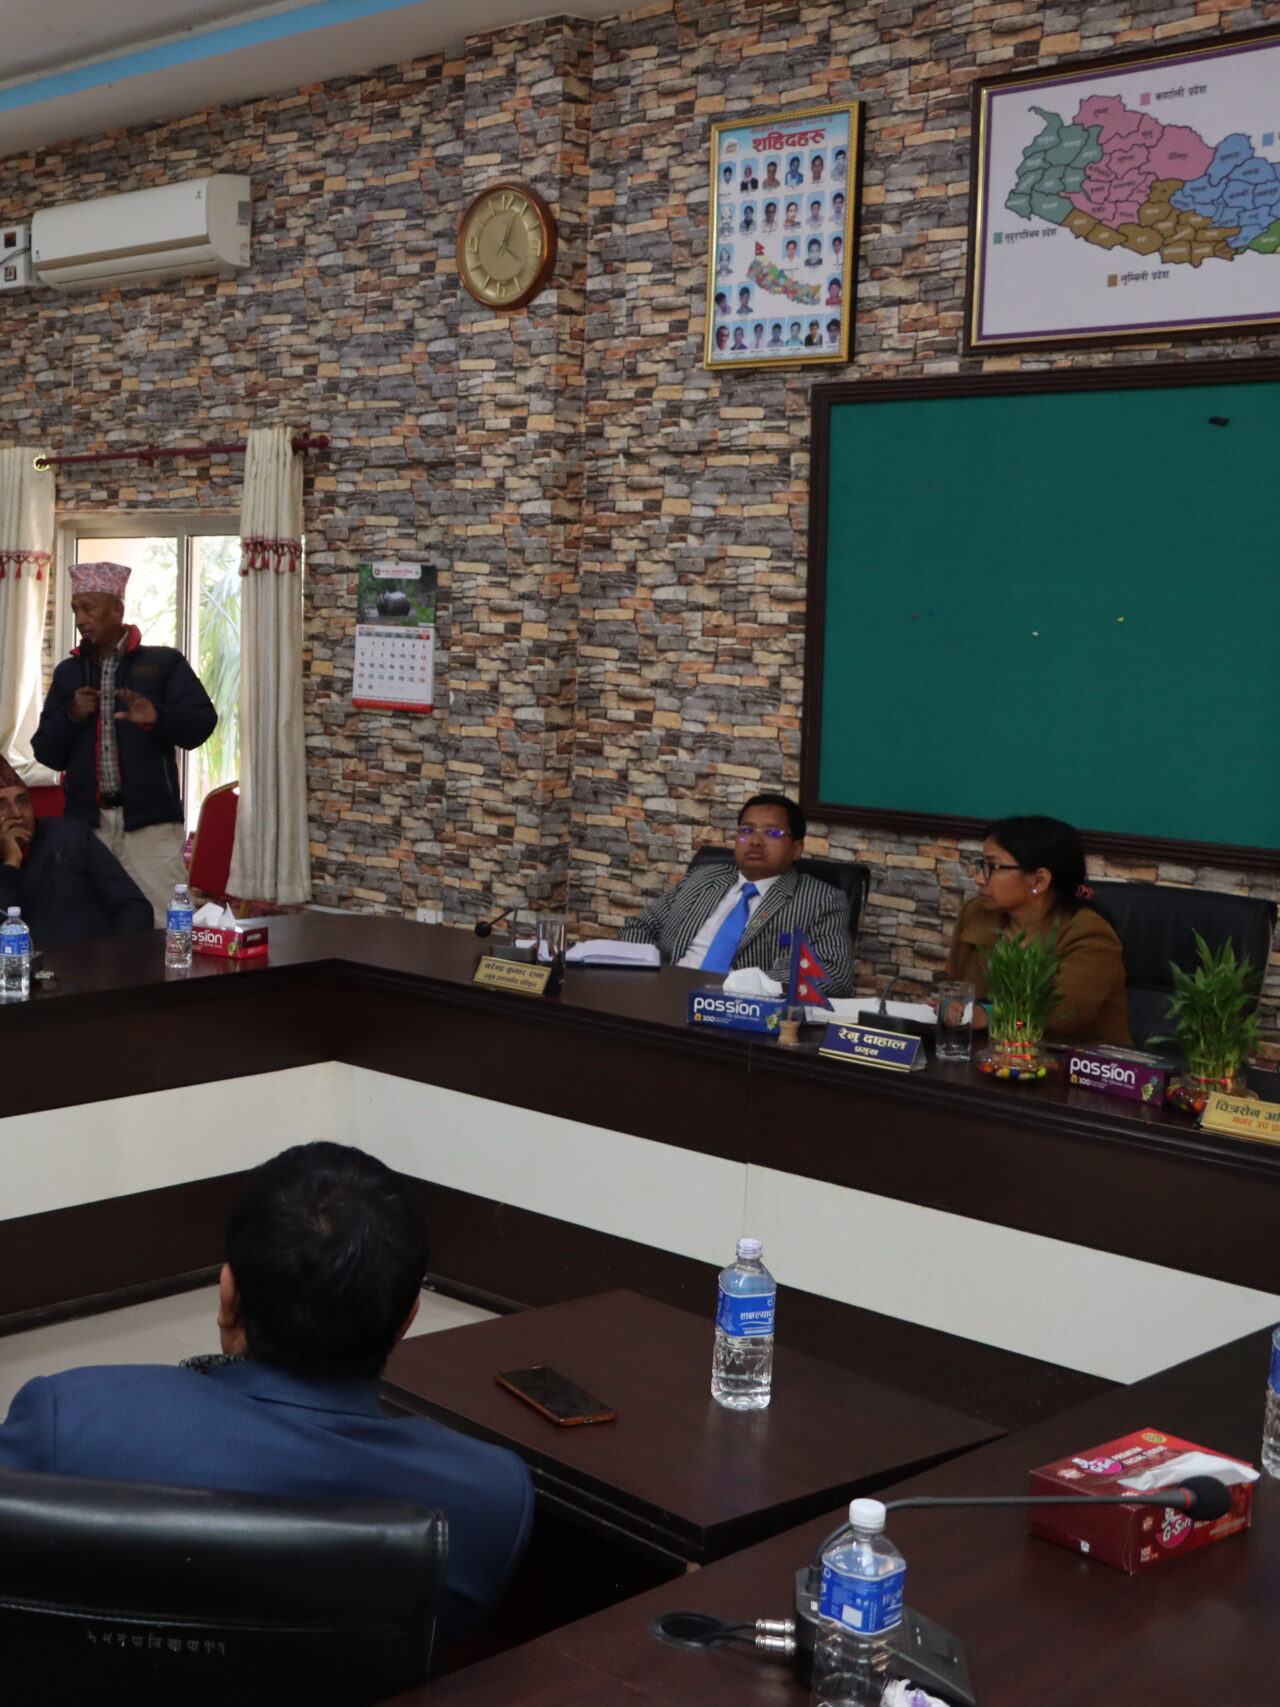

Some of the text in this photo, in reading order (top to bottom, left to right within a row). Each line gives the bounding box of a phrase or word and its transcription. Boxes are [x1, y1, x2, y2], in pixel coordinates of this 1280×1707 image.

[191, 930, 223, 945] ssion
[693, 997, 760, 1017] passion
[703, 1014, 716, 1023] 100
[838, 1028, 907, 1050] रेनु दाहाल
[854, 1045, 879, 1056] प्रमुख
[1070, 1057, 1136, 1085] passion
[1078, 1076, 1091, 1086] 100
[1163, 1517, 1192, 1542] G-Soft
